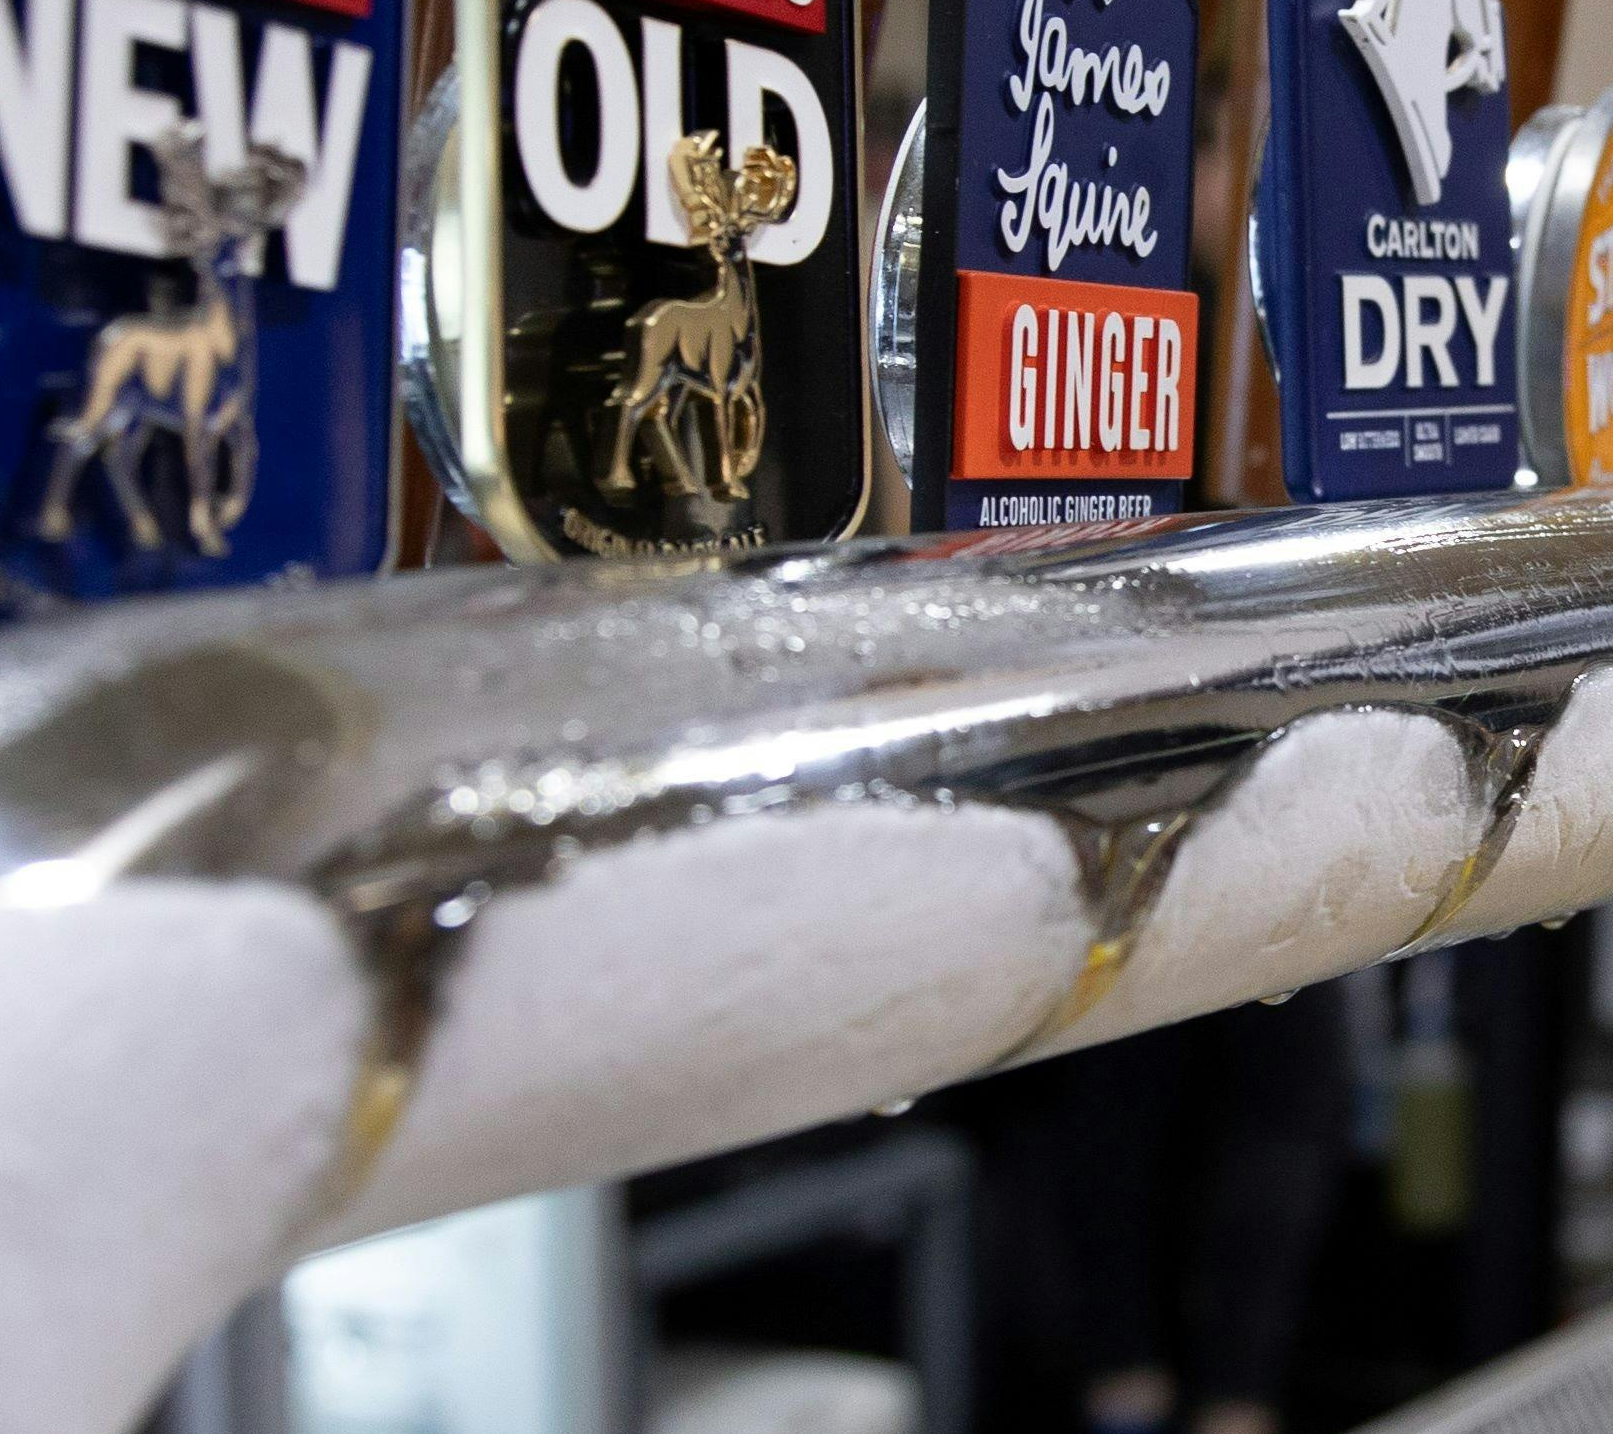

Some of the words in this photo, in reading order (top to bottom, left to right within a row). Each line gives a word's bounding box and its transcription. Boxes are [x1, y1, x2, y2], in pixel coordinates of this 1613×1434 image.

[995, 90, 1159, 272] Squire
[1365, 211, 1480, 261] CARLTON
[1007, 302, 1182, 454] GINGER
[1340, 273, 1510, 392] DRY
[978, 495, 1063, 527] ALCOHOLIC
[1064, 495, 1116, 524] GINGER
[1117, 494, 1153, 518] BEER
